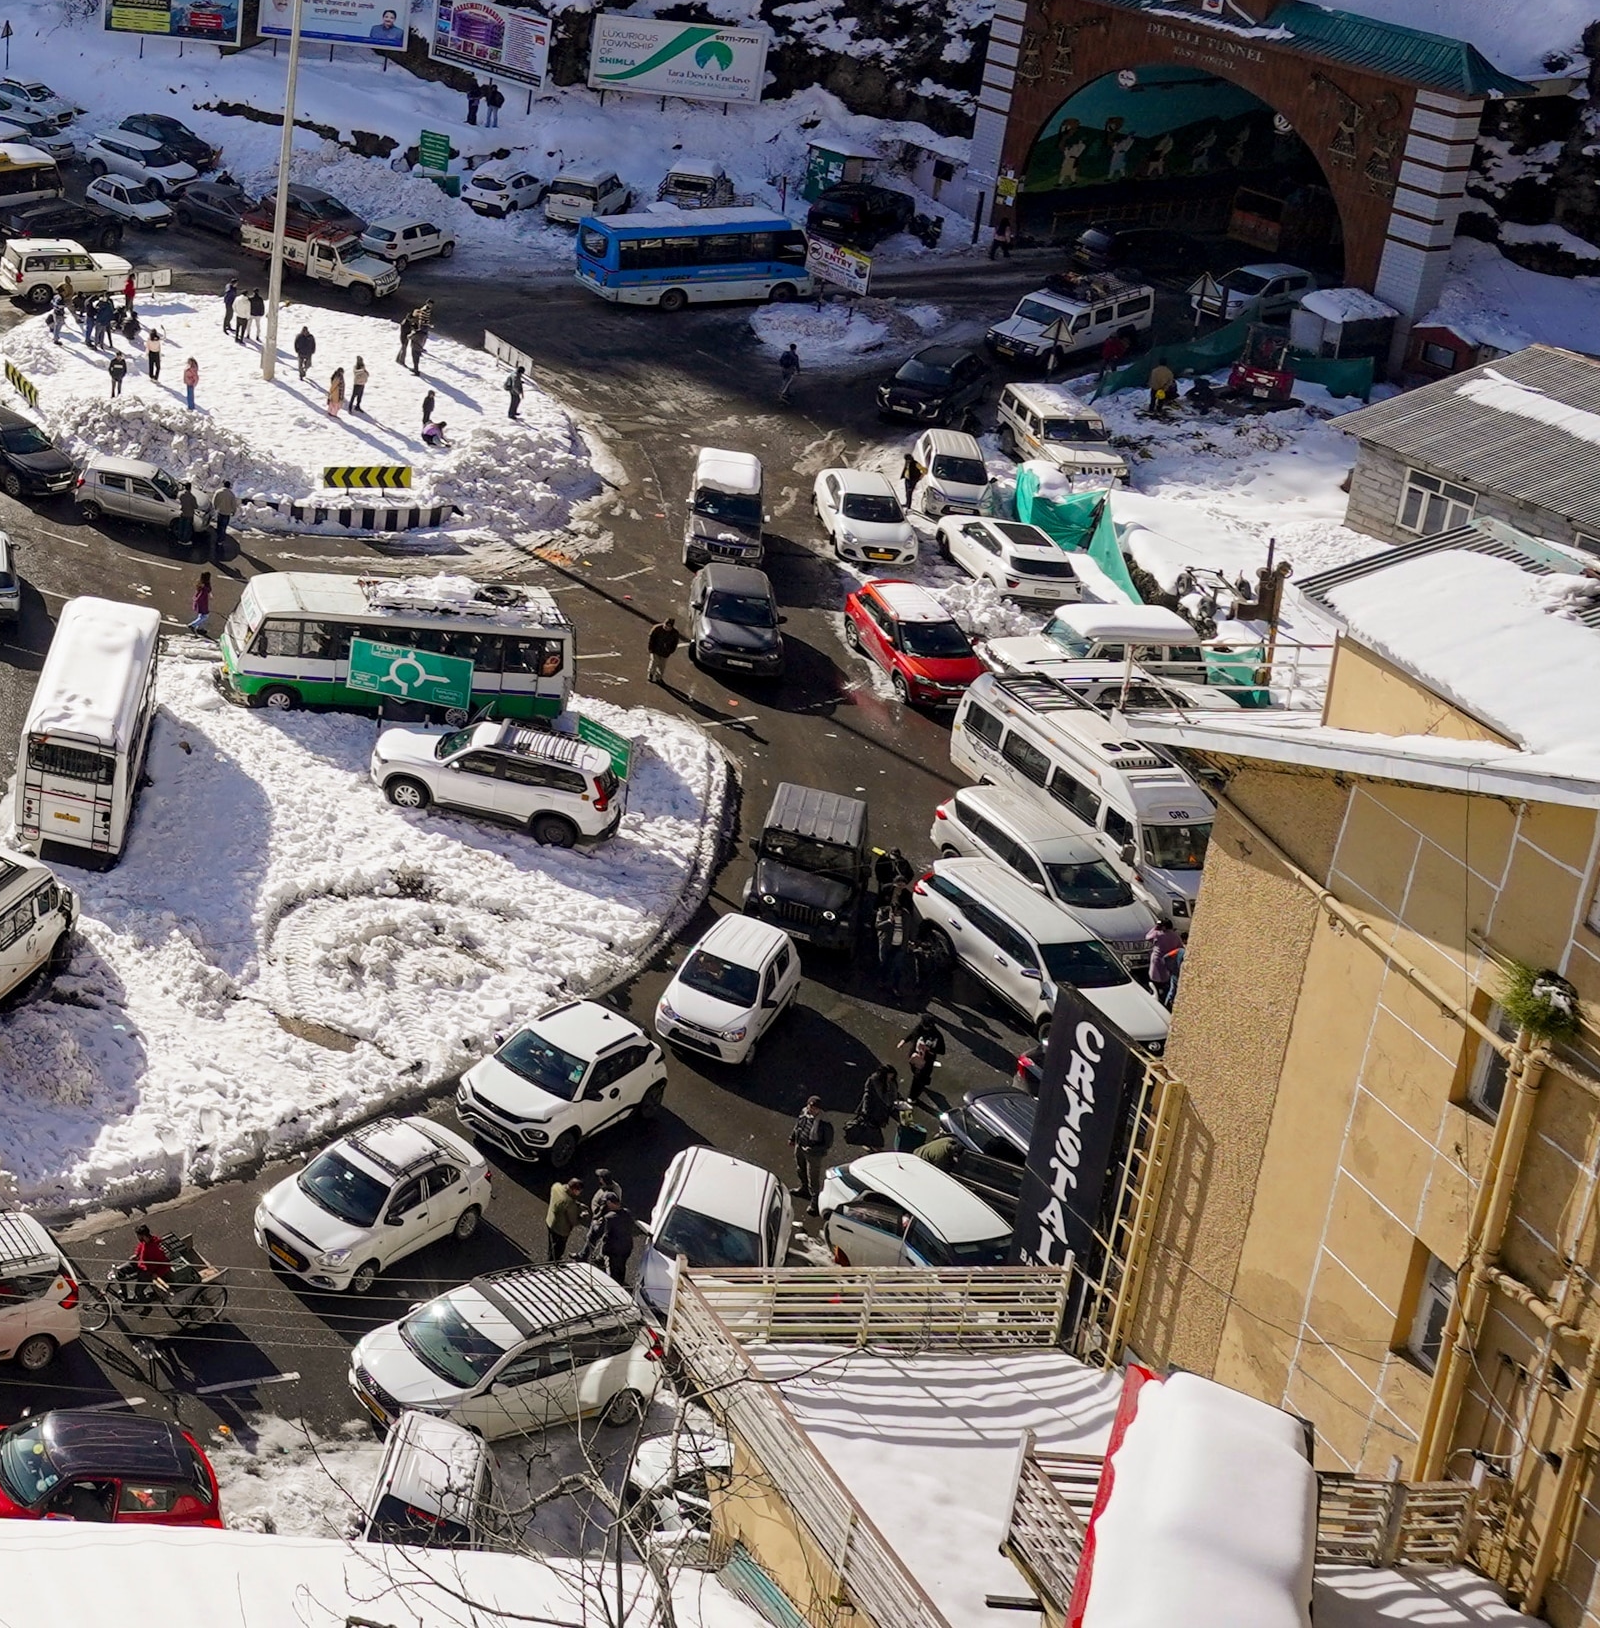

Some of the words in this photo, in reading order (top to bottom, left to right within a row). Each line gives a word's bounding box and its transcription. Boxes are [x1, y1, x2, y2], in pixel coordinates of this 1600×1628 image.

[602, 30, 659, 42] LUXURIOUS
[602, 39, 654, 50] TOWNSHIP
[1147, 23, 1200, 45] DHALLI
[1205, 36, 1266, 63] TUNNEL
[600, 47, 613, 55] OF
[598, 56, 636, 66] SHIMLA
[668, 69, 685, 78] Tara
[686, 71, 714, 81] Devi's
[716, 74, 751, 84] Enclave
[834, 247, 846, 258] NO
[824, 252, 853, 269] ENTRY
[1168, 810, 1190, 820] GRD
[1036, 1020, 1106, 1271] CRYSTAL
